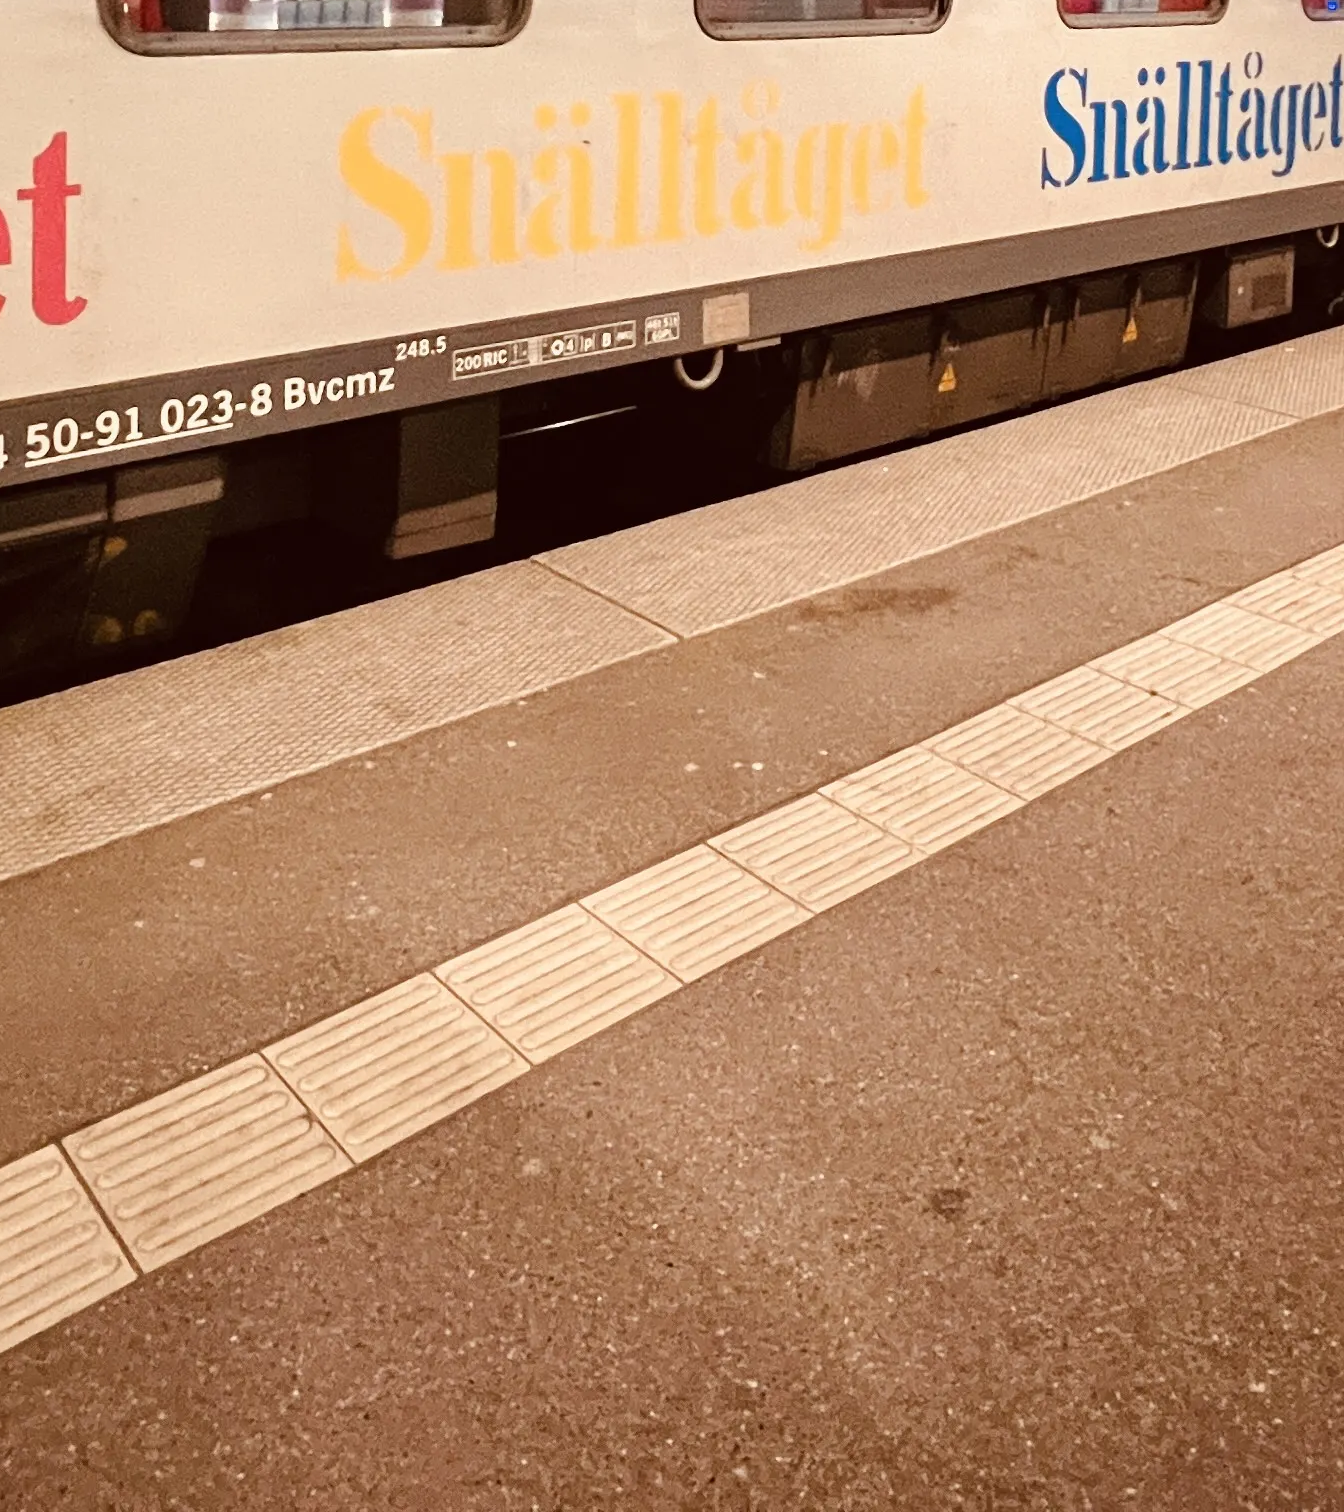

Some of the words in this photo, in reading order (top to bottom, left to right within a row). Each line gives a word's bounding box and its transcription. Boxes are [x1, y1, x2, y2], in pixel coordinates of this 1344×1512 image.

[335, 77, 929, 283] Snälltåget
[1041, 51, 1344, 190] Snälltåget
[25, 406, 144, 460] 50-91
[159, 381, 274, 435] 023-8
[283, 366, 396, 411] Bvcmz
[394, 335, 448, 361] 248.5
[455, 353, 482, 373] 200
[483, 348, 508, 368] RIC
